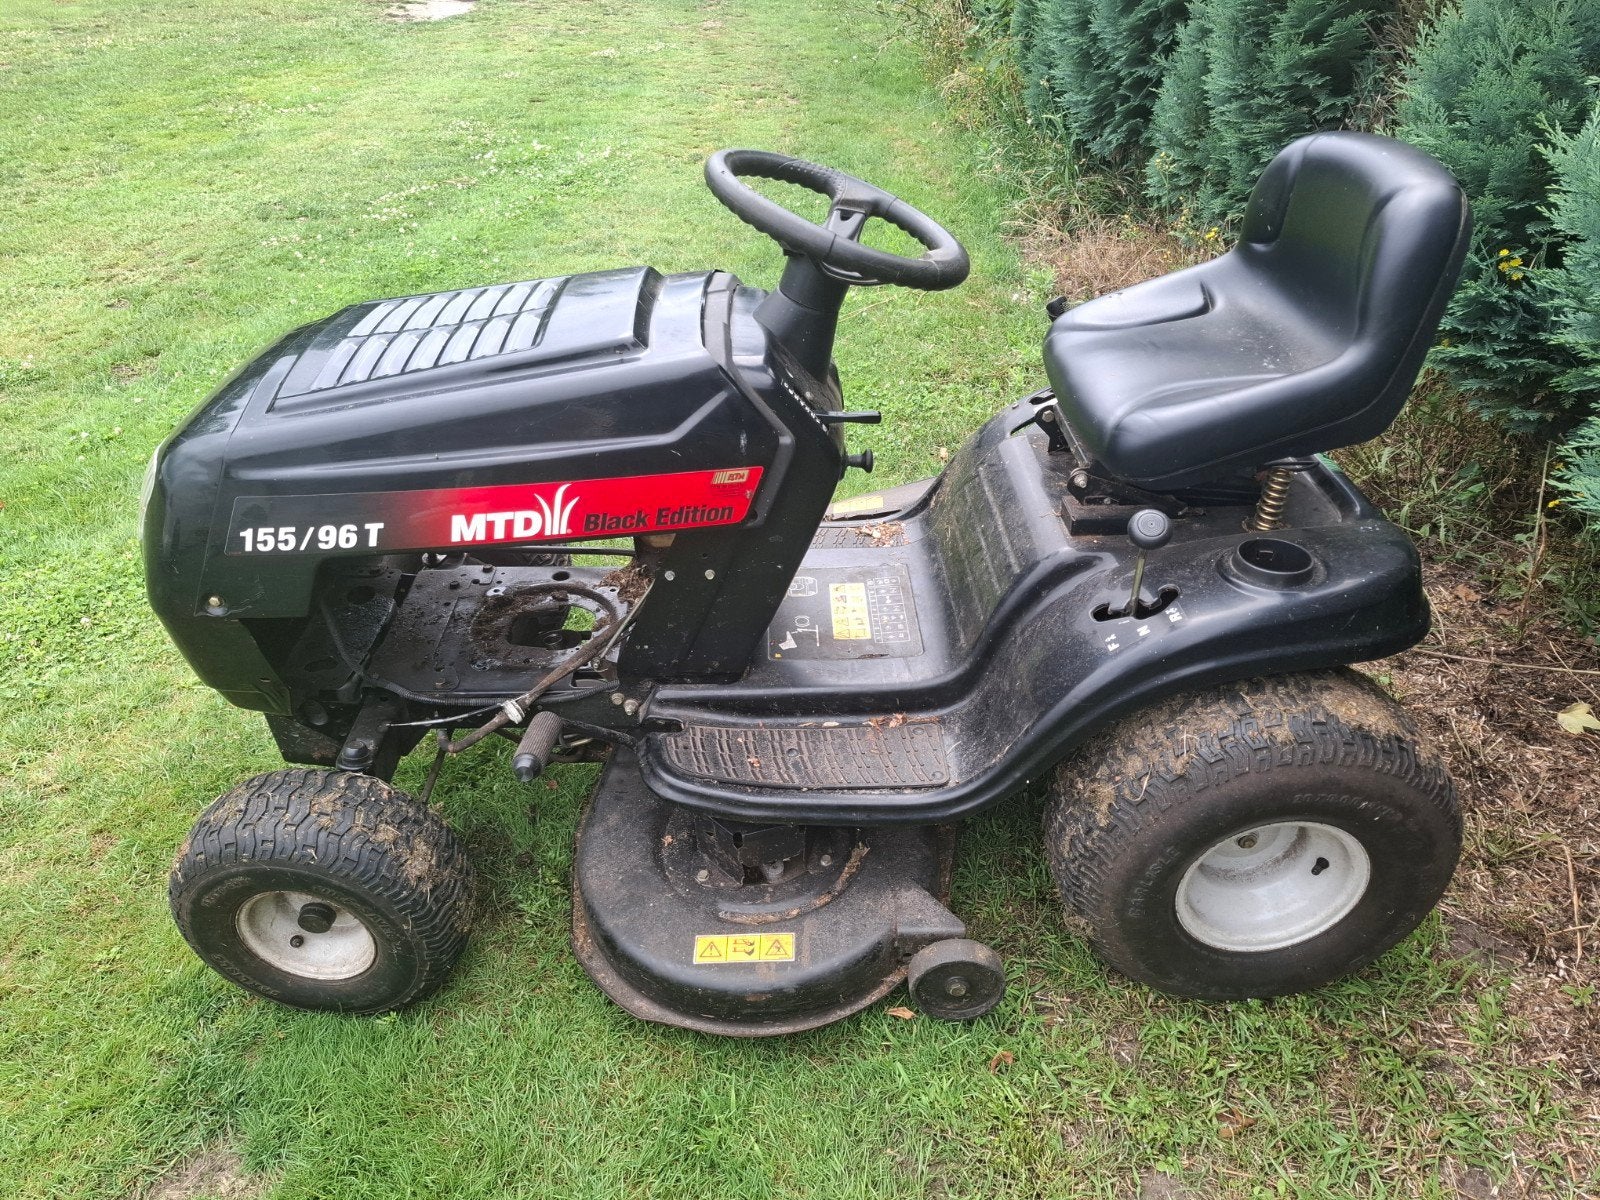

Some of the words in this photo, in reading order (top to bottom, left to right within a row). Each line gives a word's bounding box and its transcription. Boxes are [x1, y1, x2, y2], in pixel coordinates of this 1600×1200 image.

[364, 522, 385, 547] T
[451, 511, 543, 543] MTD
[583, 510, 649, 532] Black
[656, 505, 734, 526] Edition
